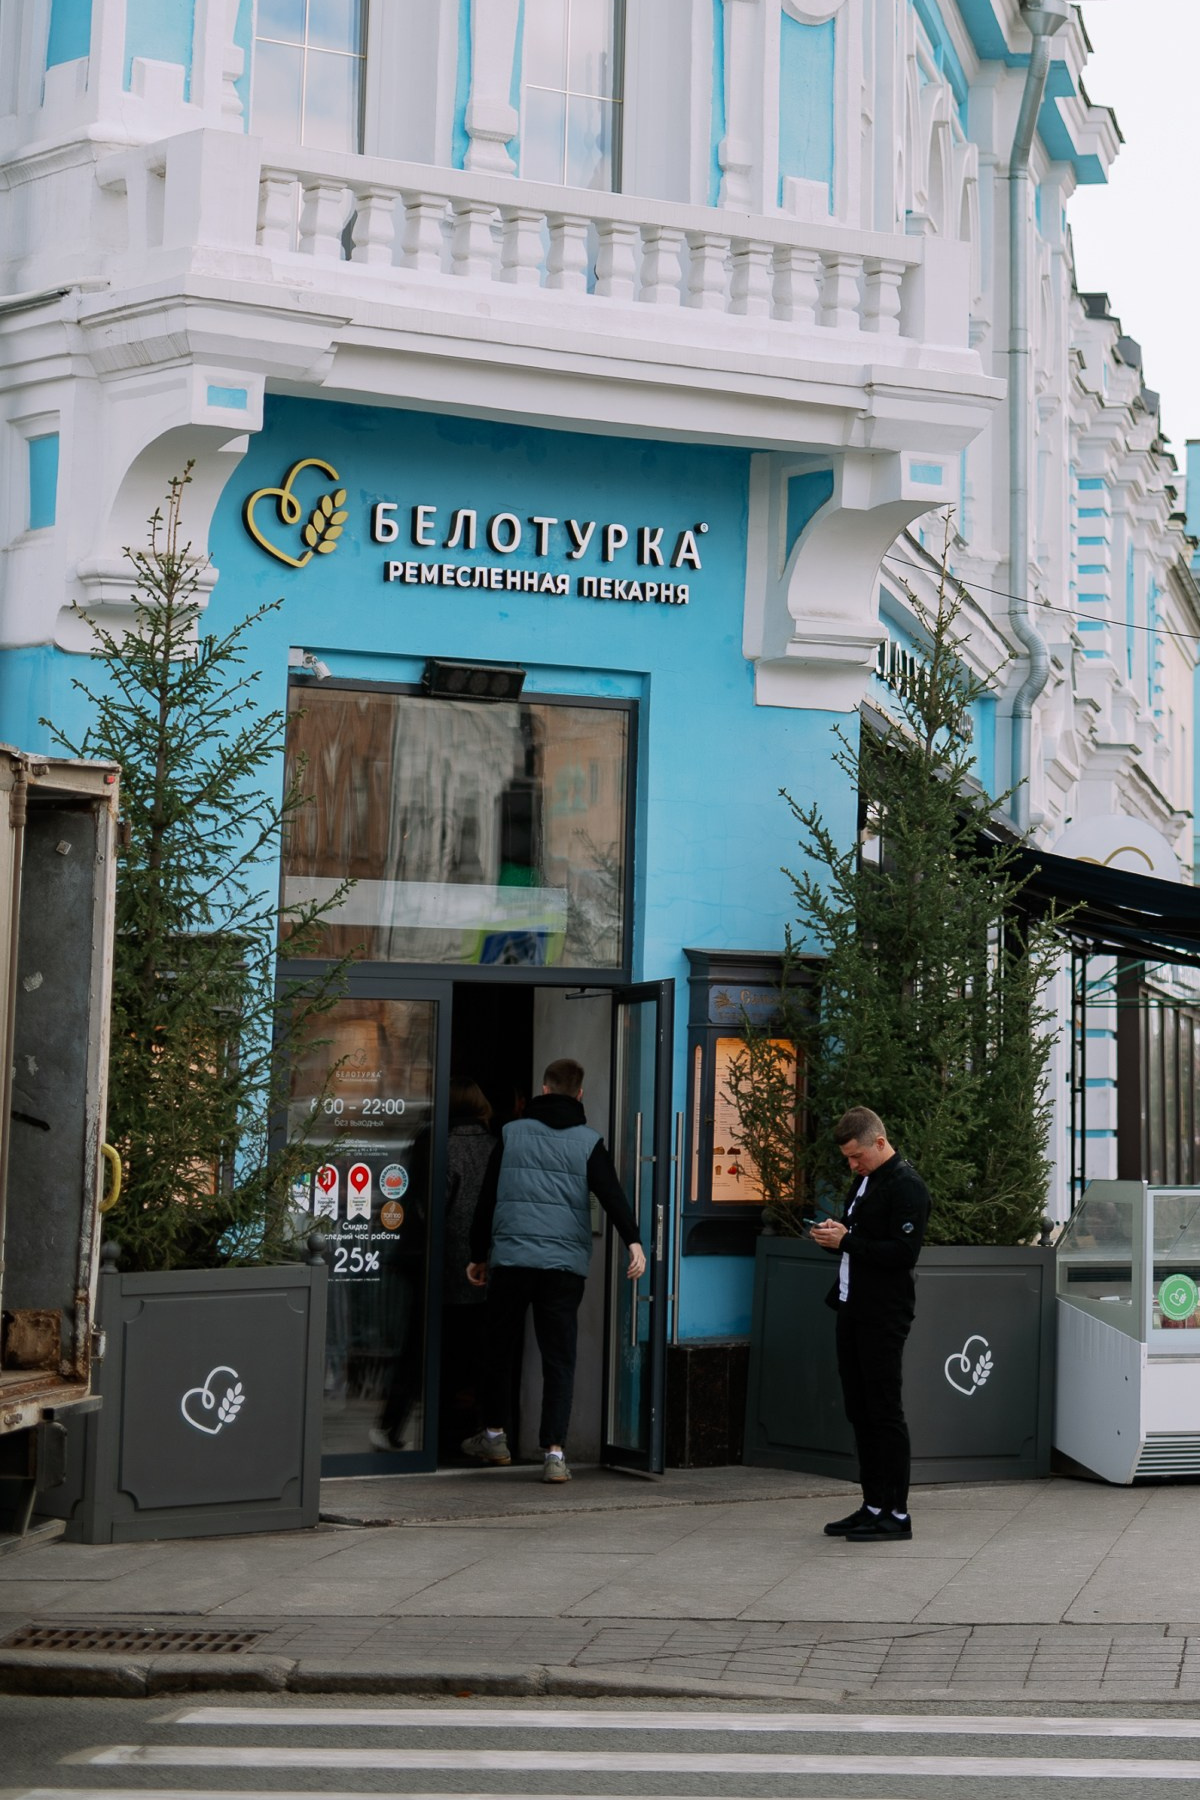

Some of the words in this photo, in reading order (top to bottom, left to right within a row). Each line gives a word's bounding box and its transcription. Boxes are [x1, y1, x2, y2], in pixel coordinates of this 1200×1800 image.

[373, 502, 703, 570] БЕЛОТУРКА
[389, 561, 571, 595] РЕМЕСЛЕННАЯ
[583, 576, 690, 605] ПЕКАРНЯ
[310, 1098, 344, 1115] 800
[362, 1098, 406, 1115] 22:00
[334, 1117, 348, 1127] без
[350, 1119, 385, 1128] выходных
[342, 1222, 369, 1231] Скидка
[324, 1232, 353, 1241] следний
[370, 1232, 400, 1241] работы
[333, 1247, 380, 1273] 25%
